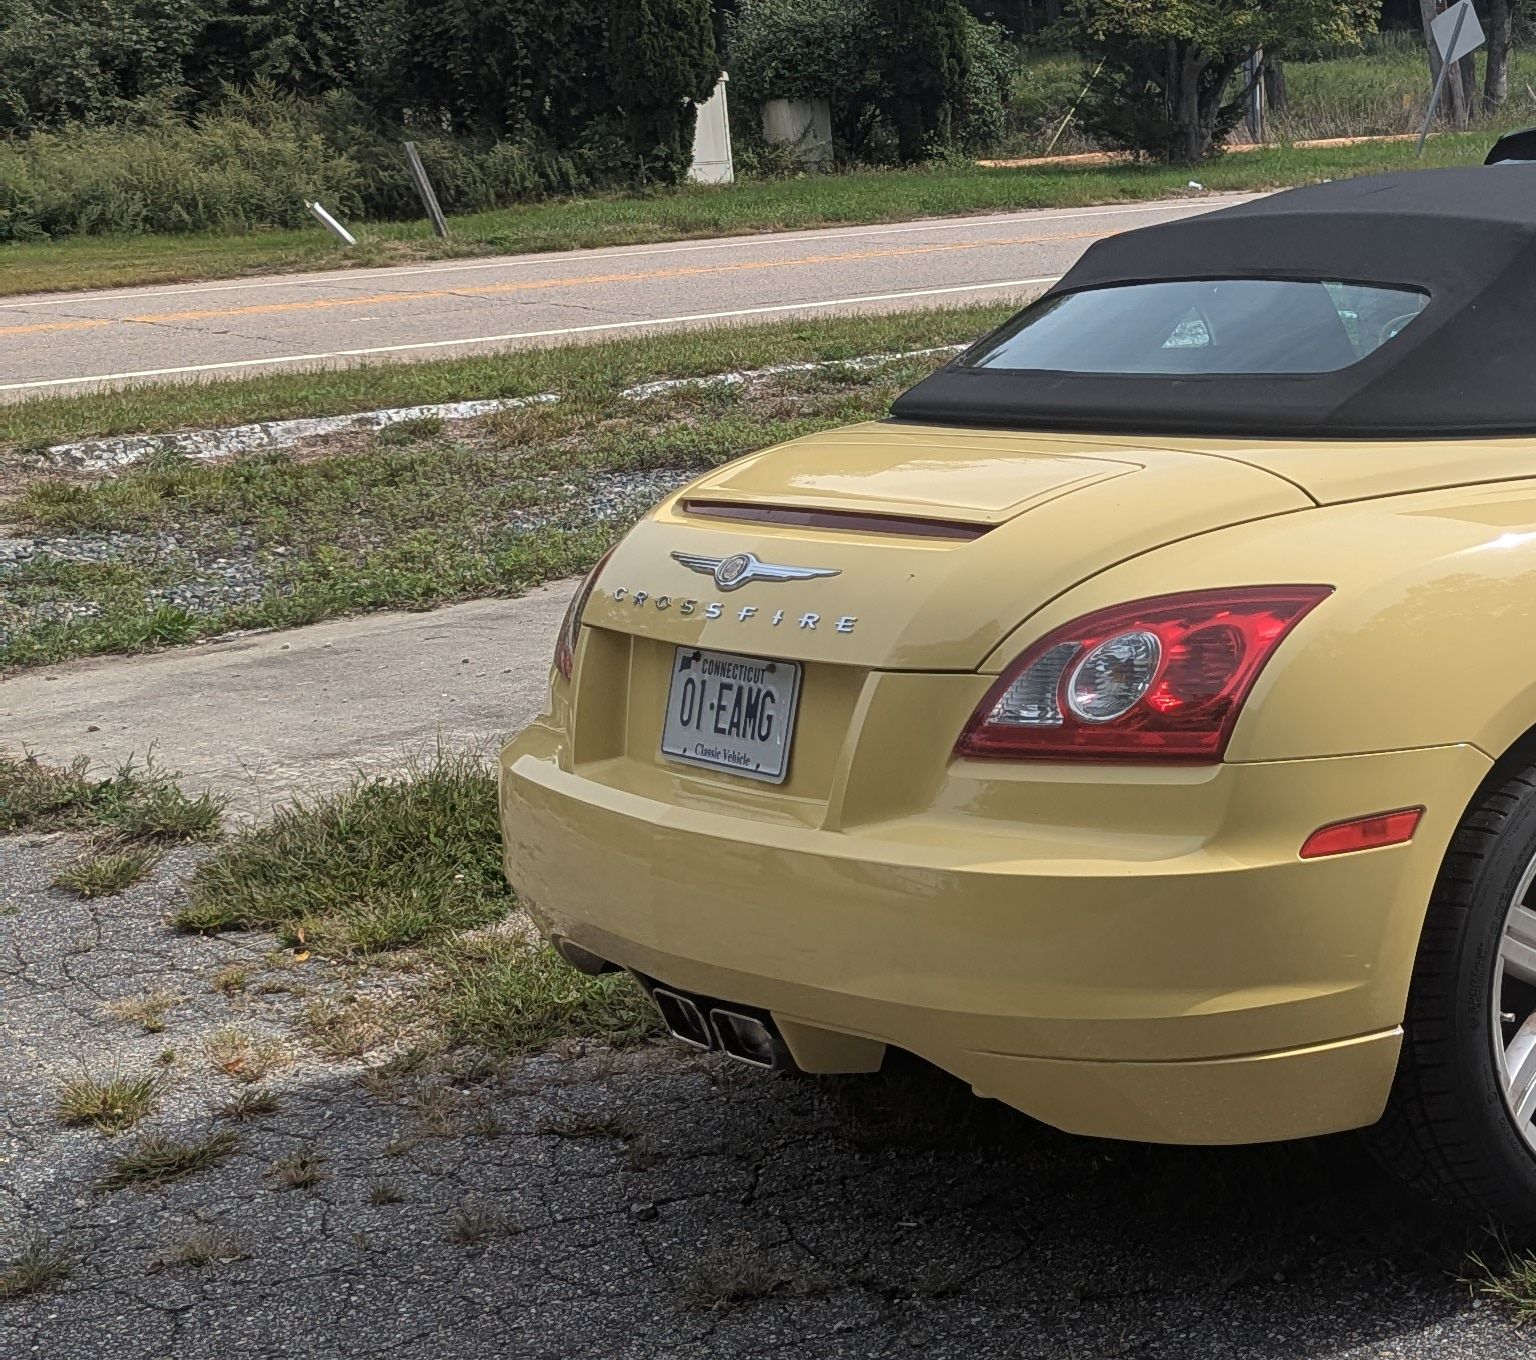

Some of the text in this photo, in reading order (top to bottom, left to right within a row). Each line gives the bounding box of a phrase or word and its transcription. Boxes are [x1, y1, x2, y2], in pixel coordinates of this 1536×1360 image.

[611, 587, 858, 633] CROSSFIRE
[701, 658, 767, 685] CONNECTICUT
[694, 742, 751, 766] Classic Vehicle
